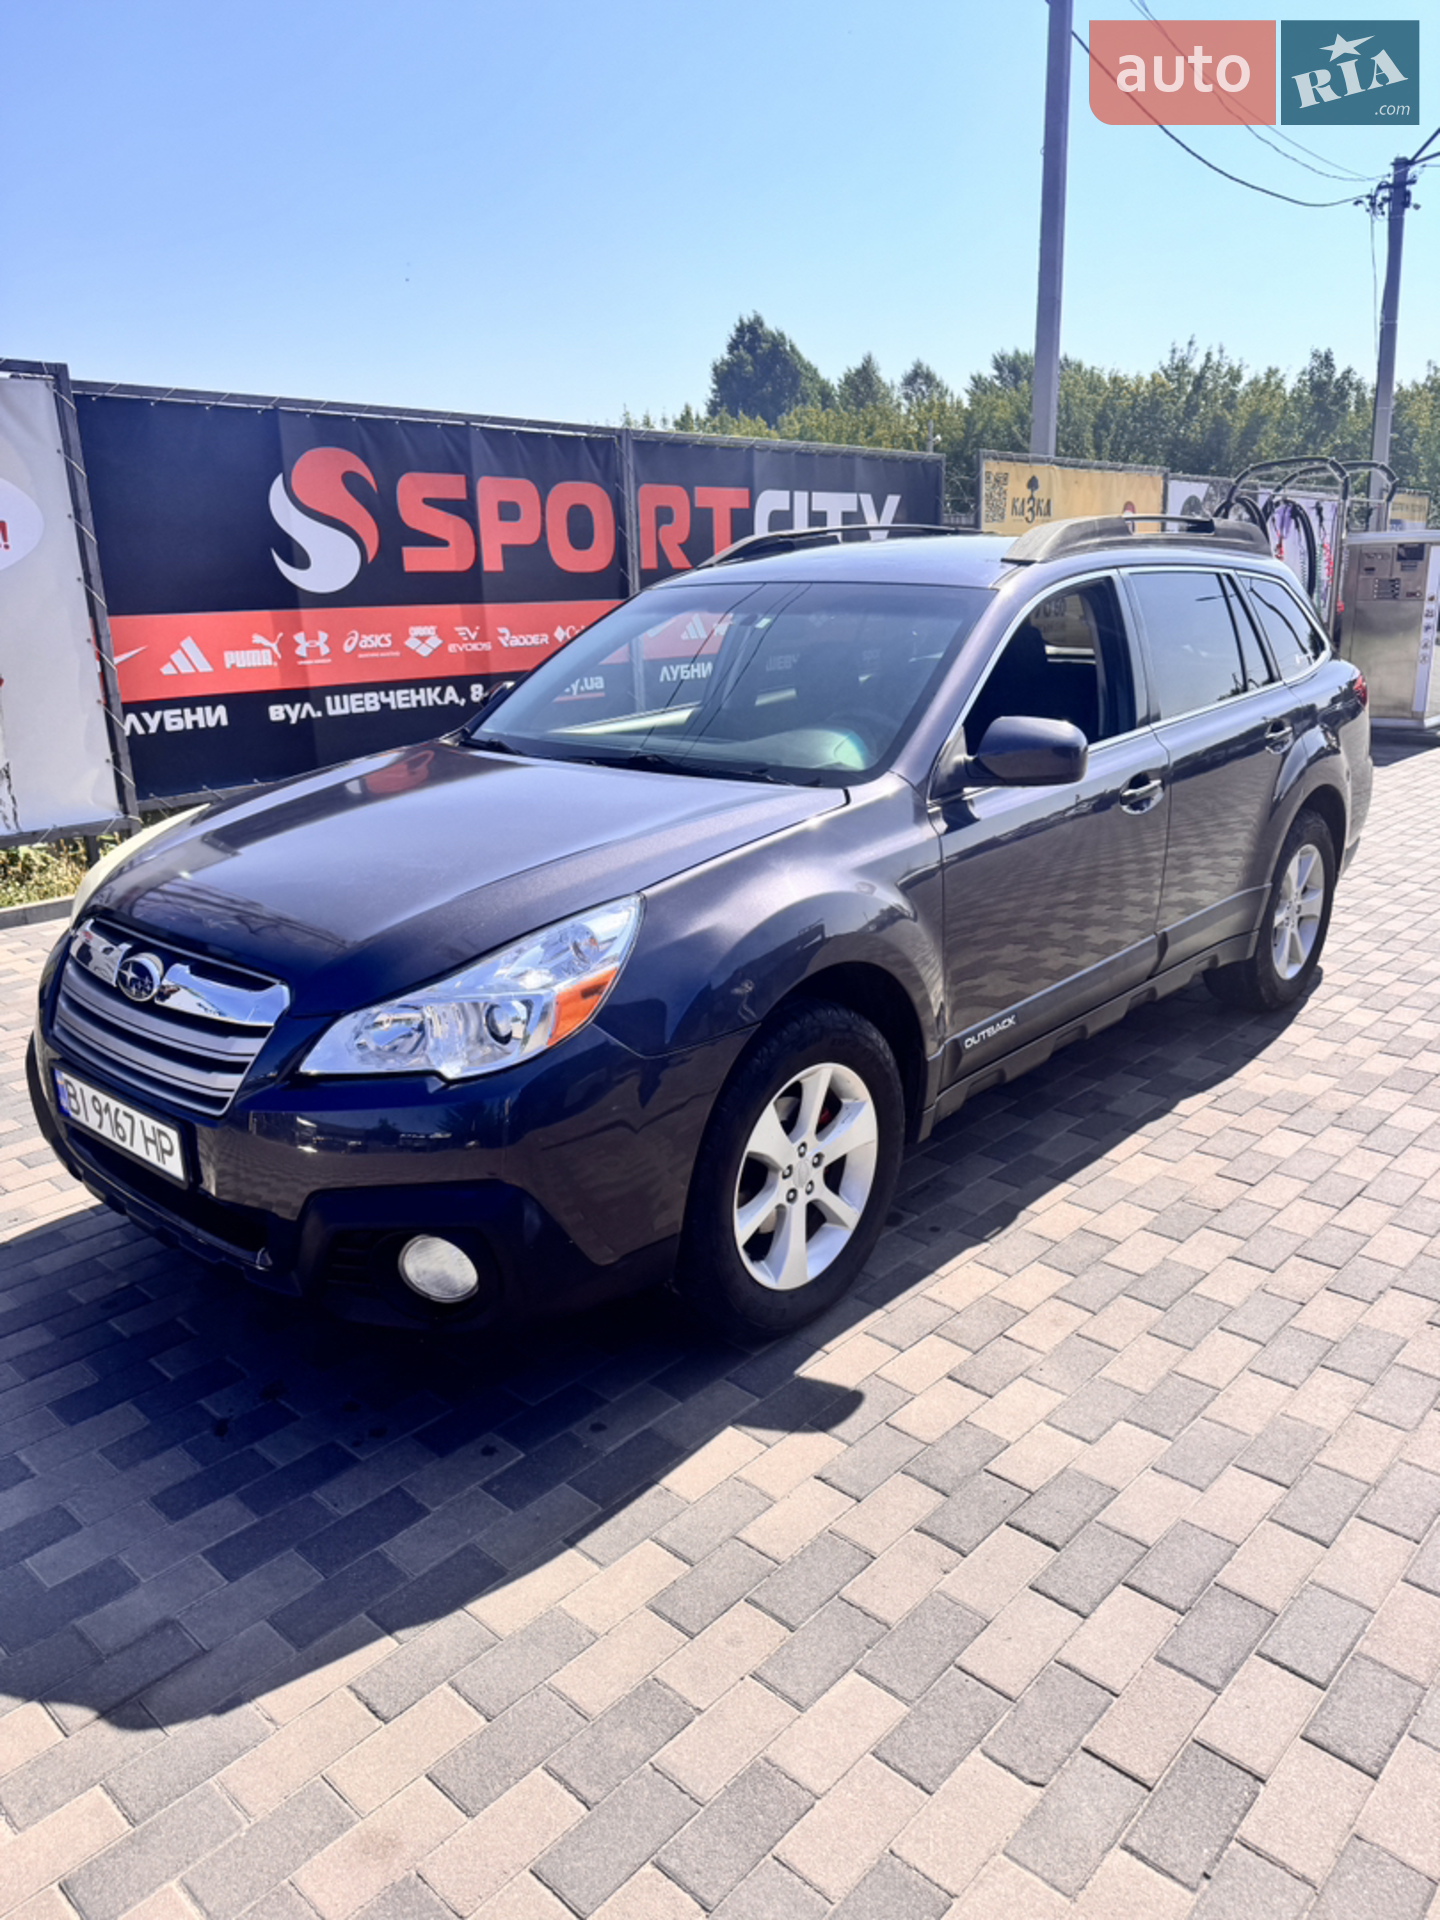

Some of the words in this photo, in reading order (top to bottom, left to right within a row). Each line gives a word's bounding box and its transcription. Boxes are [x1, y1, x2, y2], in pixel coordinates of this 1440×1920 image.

[223, 649, 274, 669] PUMA
[659, 661, 713, 683] ЛУБНИ
[125, 705, 229, 737] ЛУБНИ
[268, 703, 323, 725] вул.
[325, 684, 467, 716] ШЕВЧЕНКА,
[964, 1014, 1017, 1050] OUTBACK
[64, 1079, 90, 1123] BI
[91, 1094, 136, 1149] 9167
[139, 1119, 175, 1167] HP
